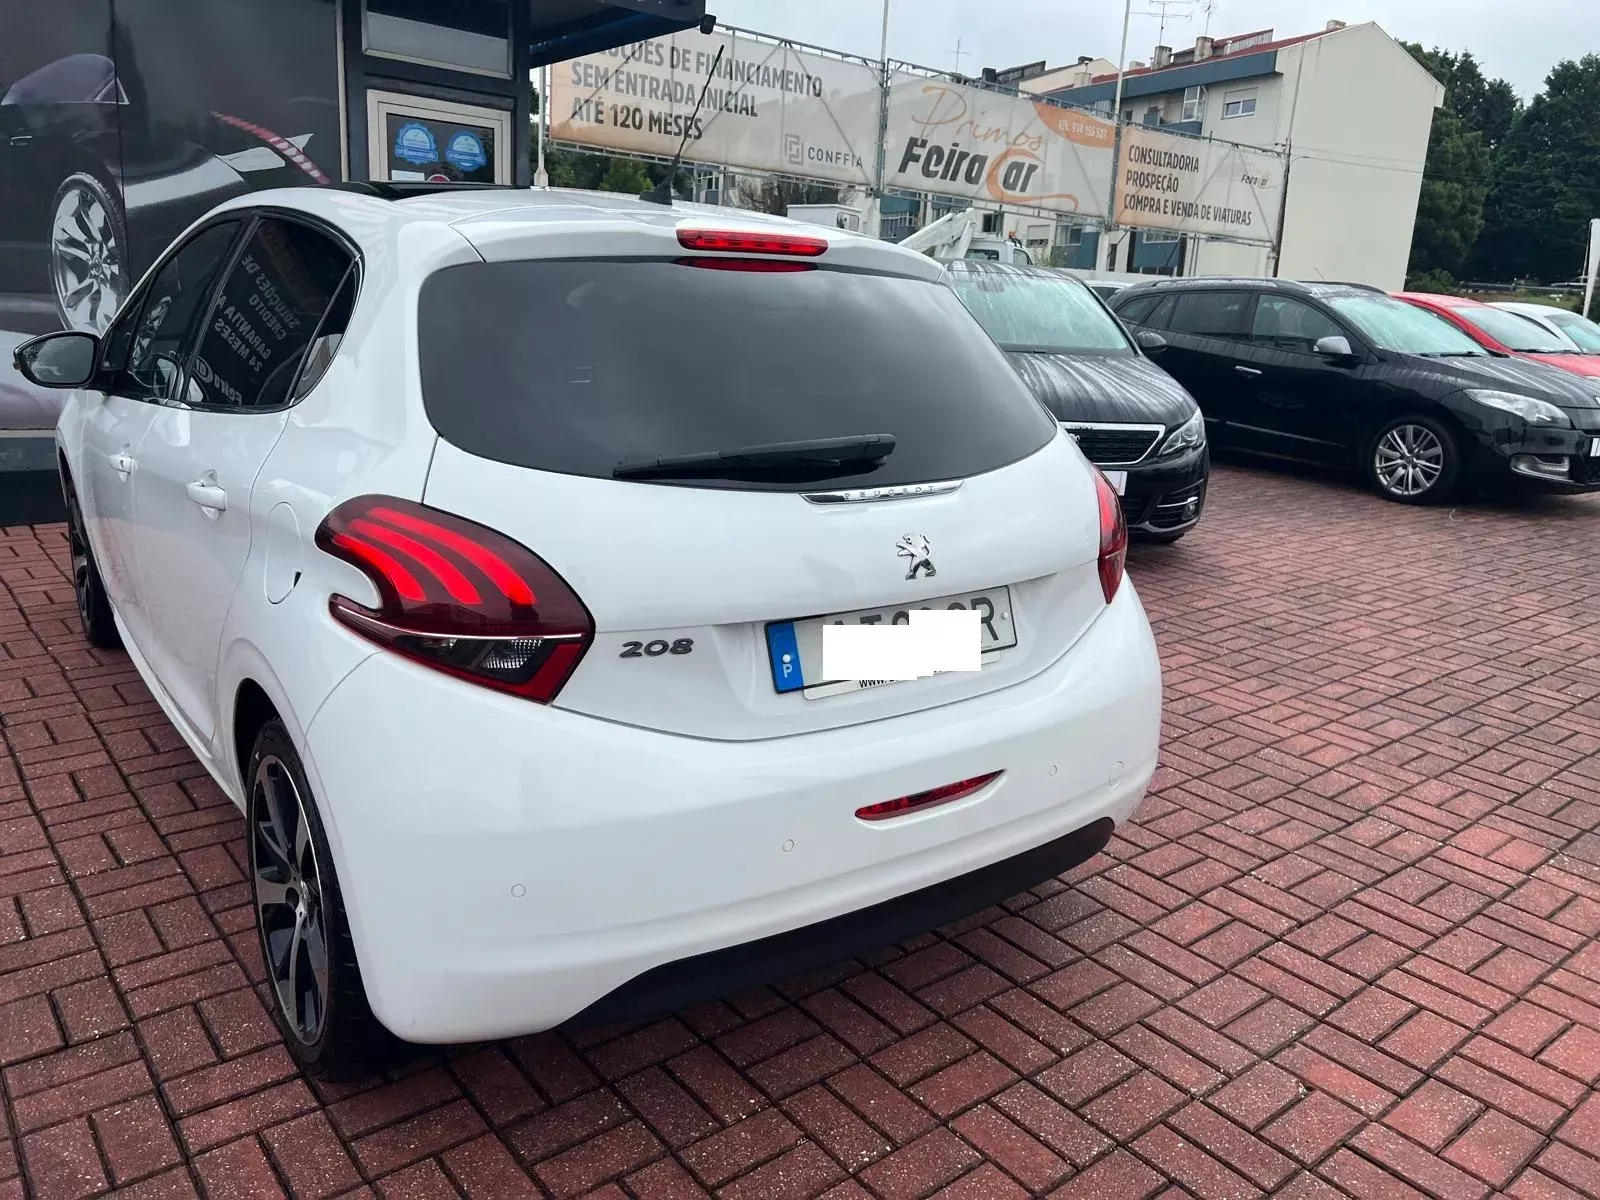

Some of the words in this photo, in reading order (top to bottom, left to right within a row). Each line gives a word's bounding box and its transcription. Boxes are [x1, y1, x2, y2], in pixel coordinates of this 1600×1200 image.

[671, 46, 691, 72] DE
[696, 51, 823, 98] FINANCIAMENTO
[571, 61, 609, 91] SEM
[614, 69, 696, 106] ENTRADA
[700, 85, 758, 117] INICIAL
[571, 96, 605, 125] ATÉ
[609, 103, 644, 131] 120
[648, 109, 703, 140] MESES
[807, 146, 863, 168] CONFFIA
[1128, 144, 1199, 173] CONSULTADORIA
[1126, 169, 1179, 194] PROSPEÇÃO
[1123, 193, 1161, 214] COMPRA
[1162, 199, 1169, 214] E
[1171, 199, 1199, 219] VENDA
[1200, 205, 1211, 221] DE
[1213, 208, 1252, 226] VIATURAS
[844, 484, 936, 501] PEUGEOT
[619, 639, 694, 658] 208
[782, 663, 794, 679] P
